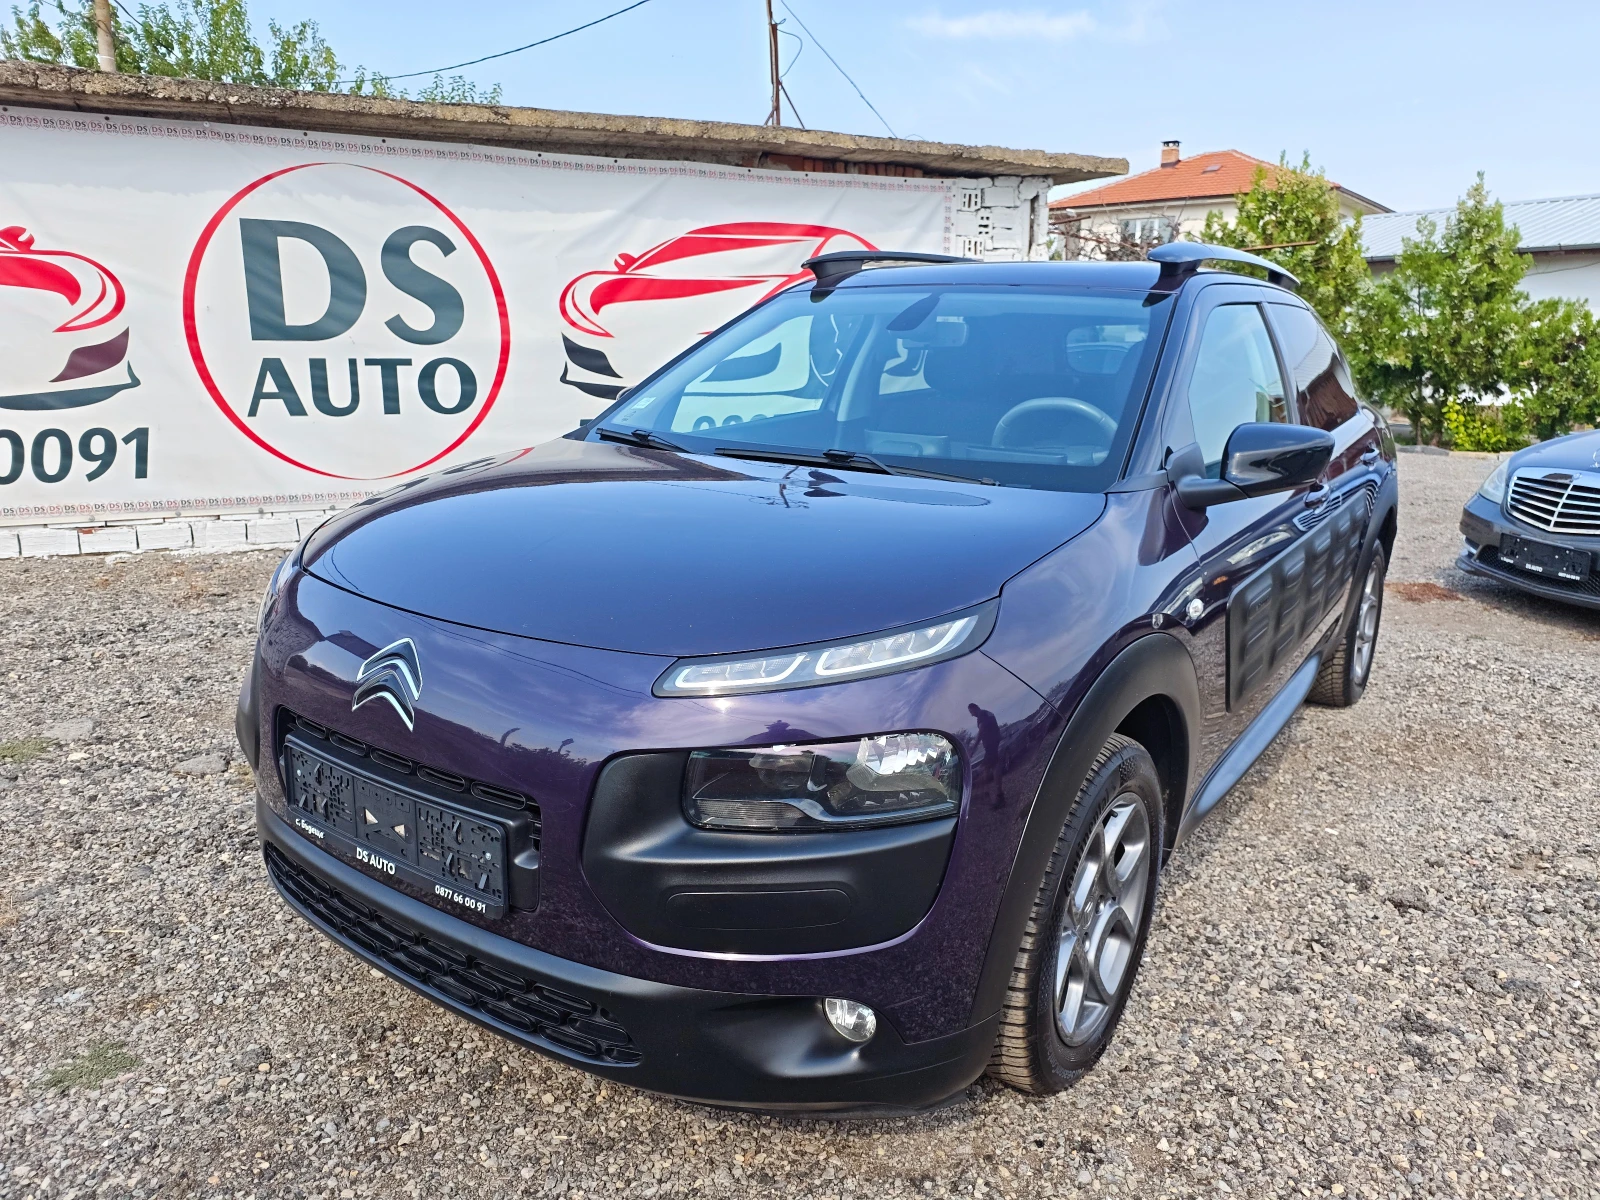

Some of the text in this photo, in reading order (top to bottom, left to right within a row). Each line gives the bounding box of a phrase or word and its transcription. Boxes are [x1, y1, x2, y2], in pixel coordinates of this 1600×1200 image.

[239, 217, 465, 346] DS
[248, 357, 478, 418] AUTO
[356, 847, 396, 875] DS AUTO
[435, 885, 486, 913] 0877 66 00 91
